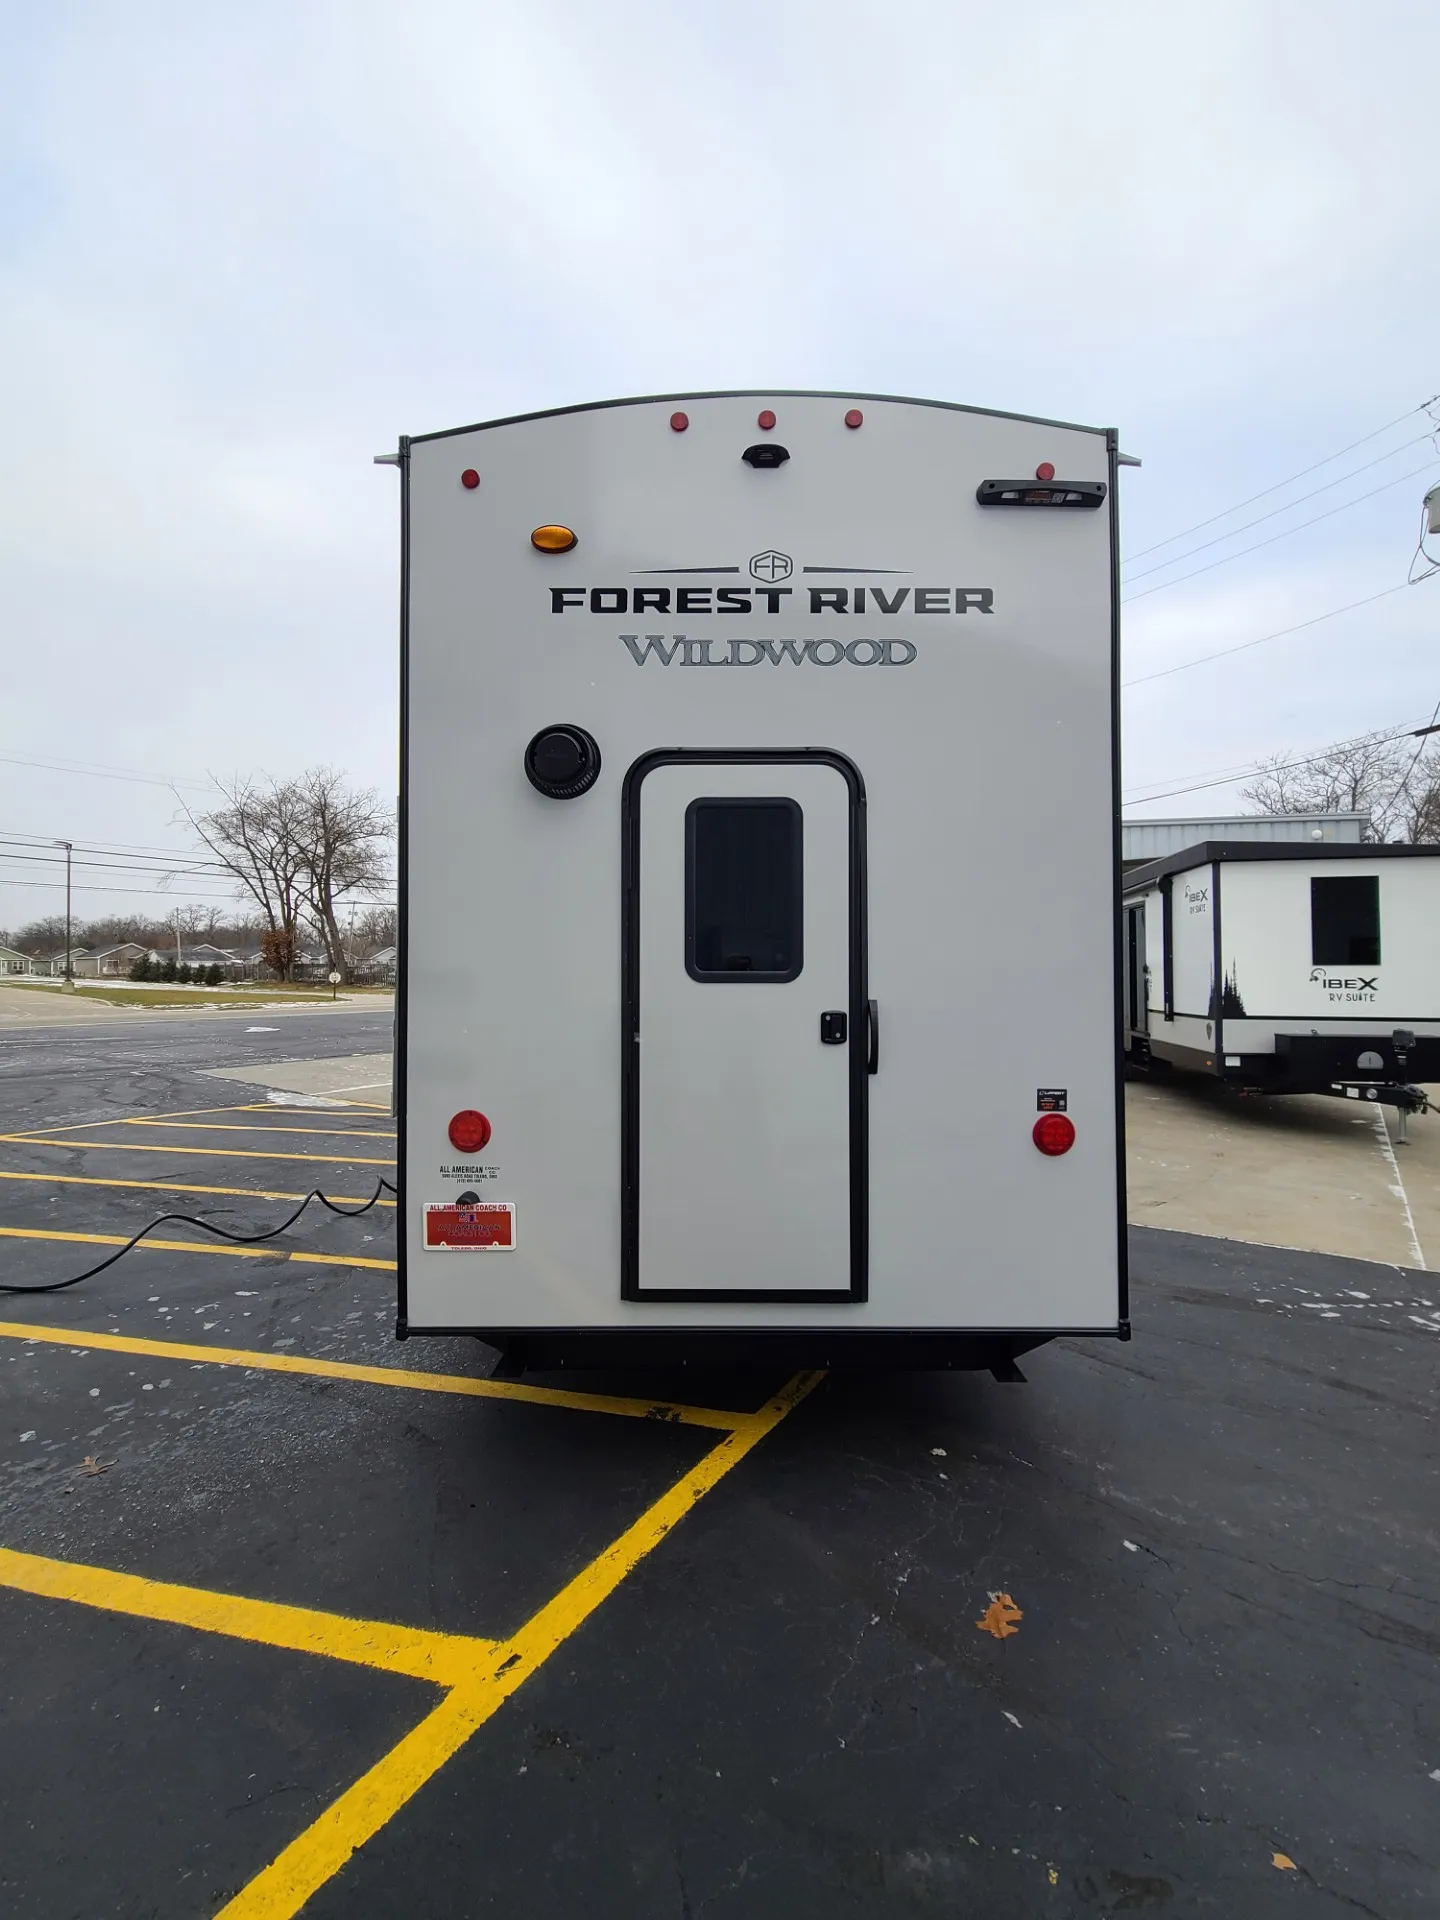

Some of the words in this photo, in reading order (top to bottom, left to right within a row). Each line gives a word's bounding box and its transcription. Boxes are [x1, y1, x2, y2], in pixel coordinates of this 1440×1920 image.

[548, 587, 793, 614] FOREST
[807, 587, 995, 614] RIVER
[618, 634, 918, 667] WILDWOOD
[1189, 888, 1208, 903] IBEX
[1323, 977, 1379, 991] IBEX
[1329, 993, 1342, 1001] RV
[439, 1165, 450, 1173] ALL
[452, 1165, 483, 1173] AMERICAN
